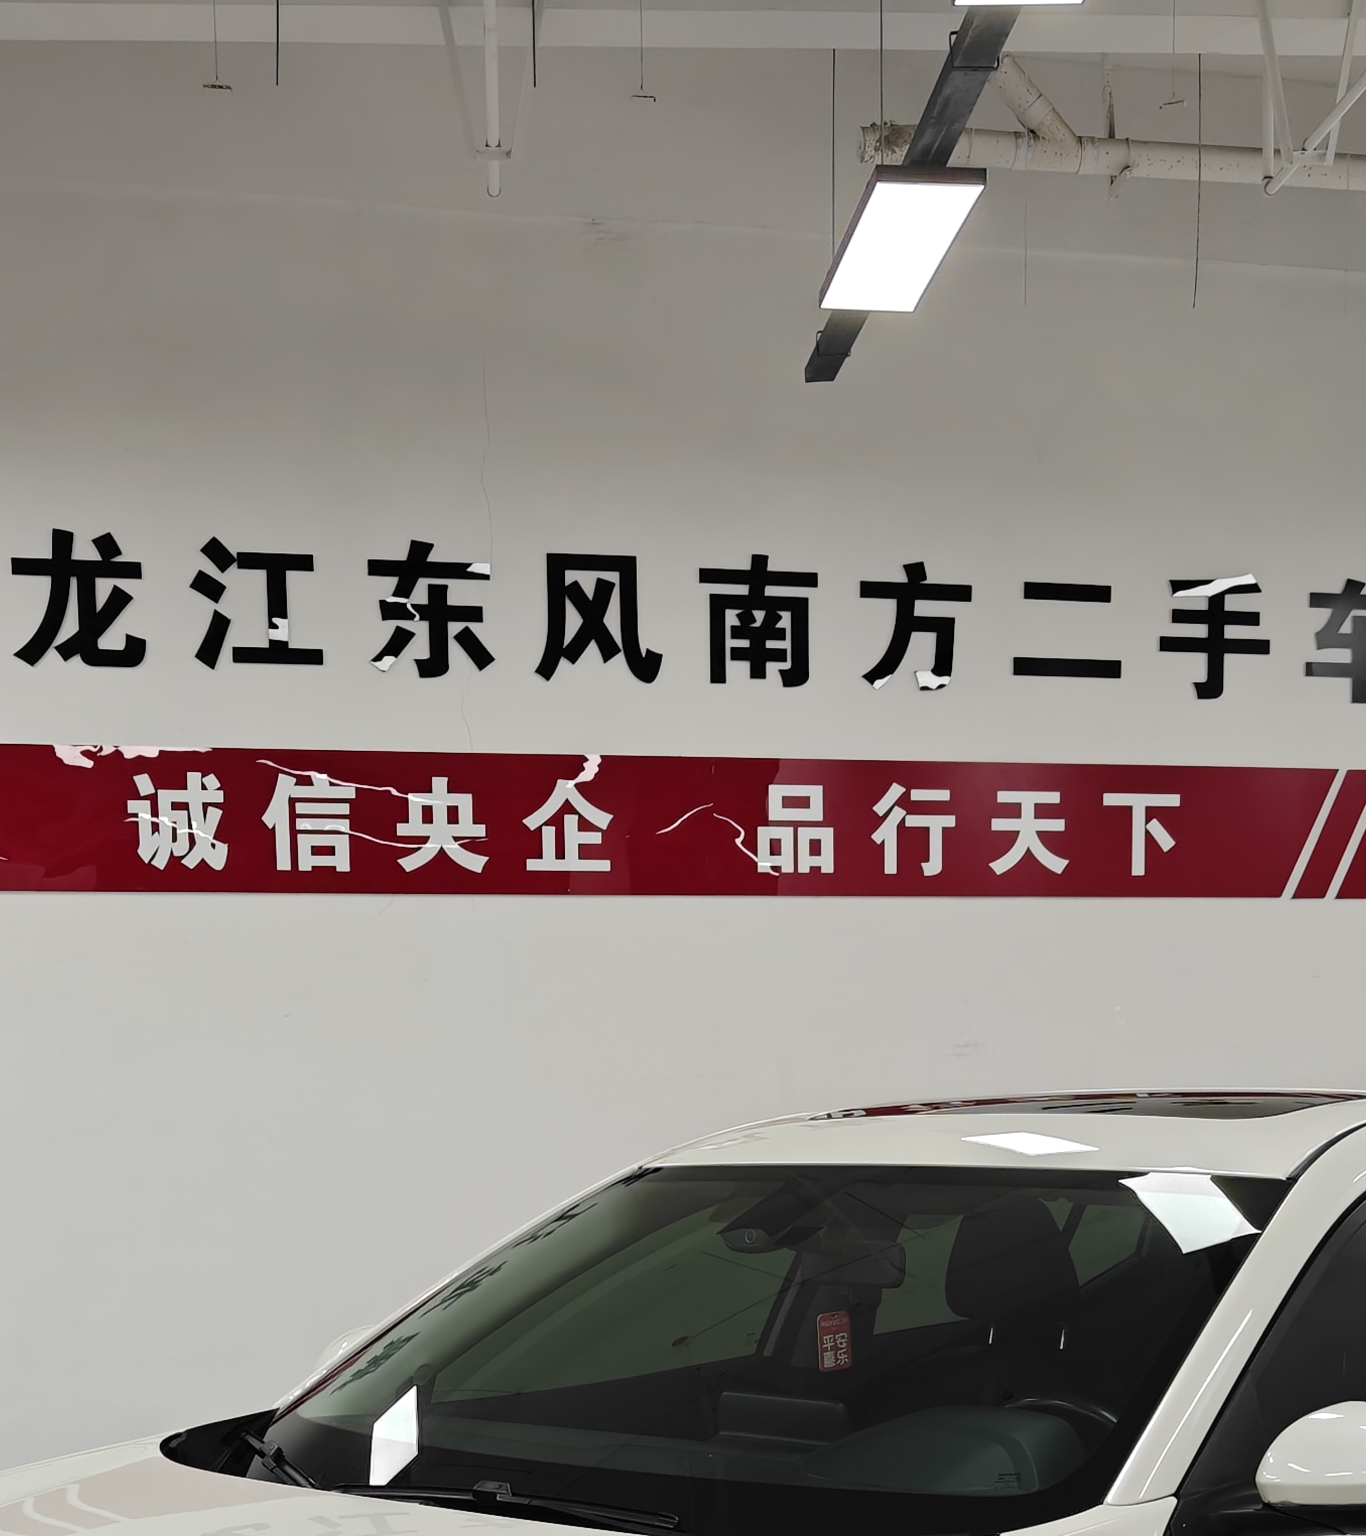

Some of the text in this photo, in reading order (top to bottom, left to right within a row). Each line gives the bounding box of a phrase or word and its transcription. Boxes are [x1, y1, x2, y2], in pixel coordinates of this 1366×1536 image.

[127, 772, 1181, 876] 诚信央企 品行天下
[823, 1333, 848, 1350] 平安
